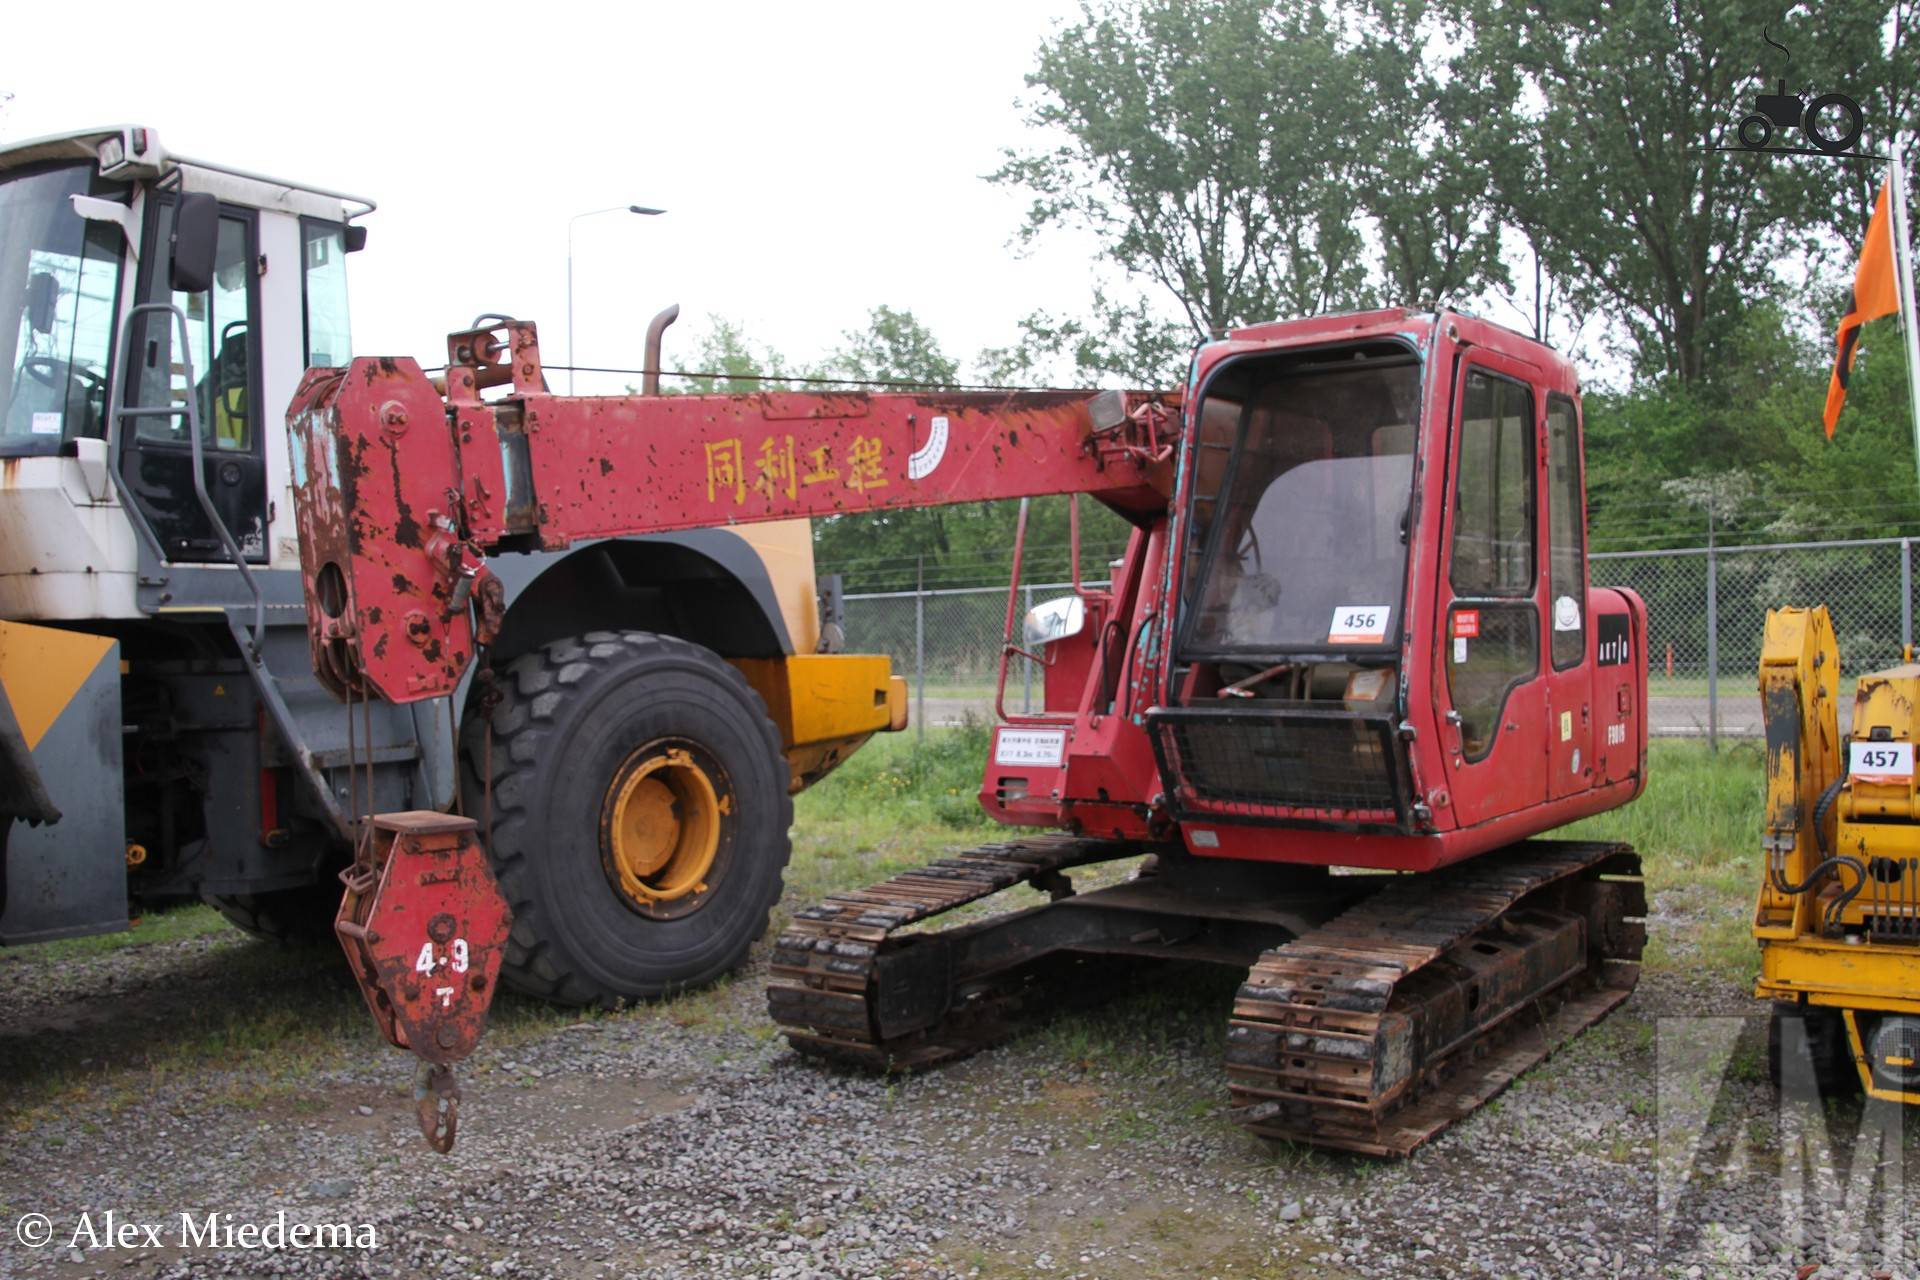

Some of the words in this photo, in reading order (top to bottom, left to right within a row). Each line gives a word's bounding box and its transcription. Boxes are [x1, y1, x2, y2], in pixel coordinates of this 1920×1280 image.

[705, 435, 889, 506] 同利工程
[1344, 613, 1376, 628] 456
[1862, 751, 1899, 767] 457
[436, 986, 455, 1007] T
